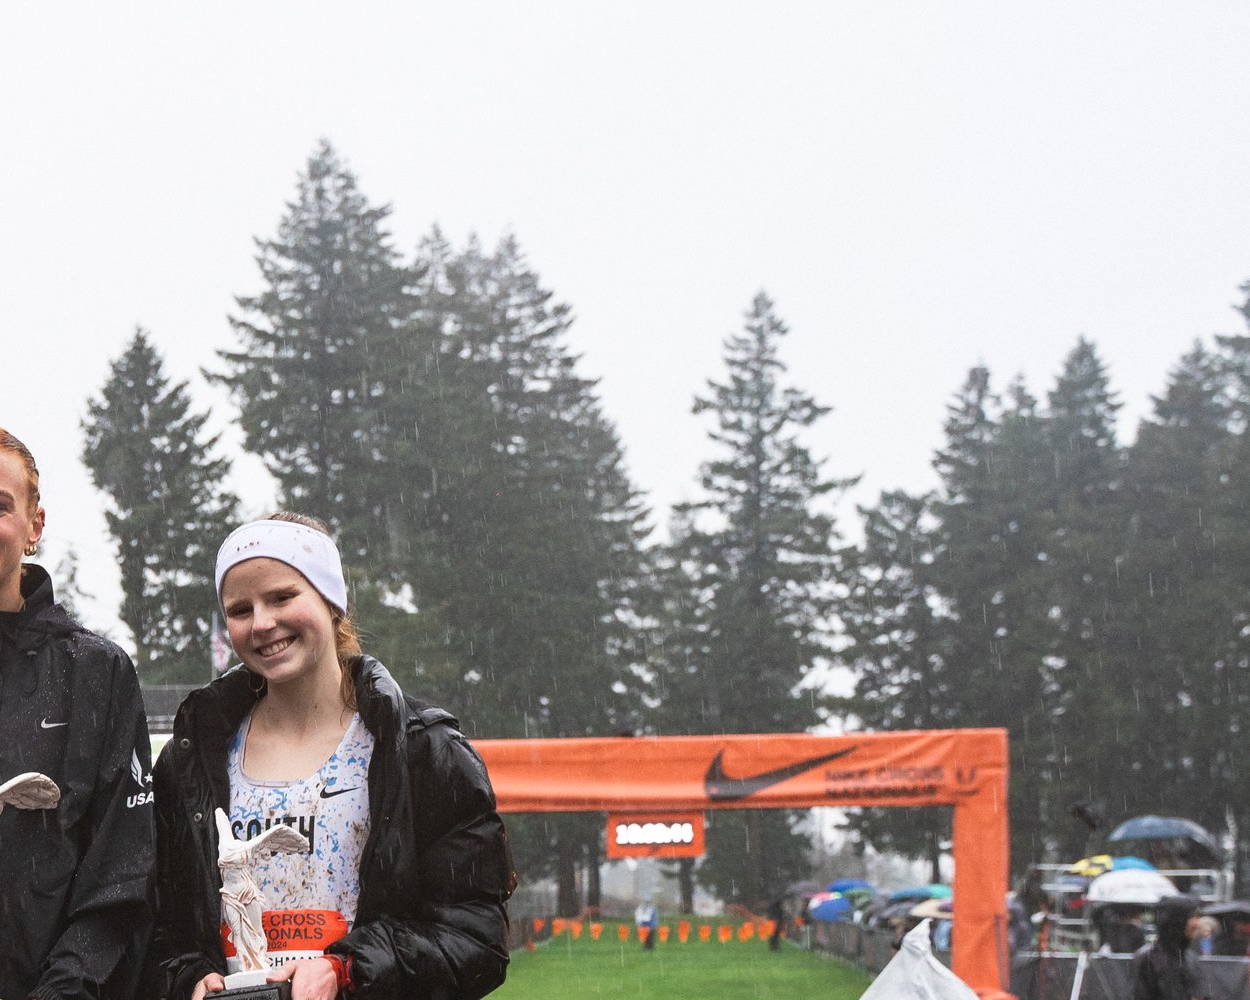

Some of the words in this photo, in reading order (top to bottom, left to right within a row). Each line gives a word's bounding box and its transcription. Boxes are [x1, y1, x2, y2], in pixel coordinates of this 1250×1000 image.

[126, 791, 154, 808] USA
[270, 913, 326, 927] CROSS
[264, 927, 323, 940] IONALS
